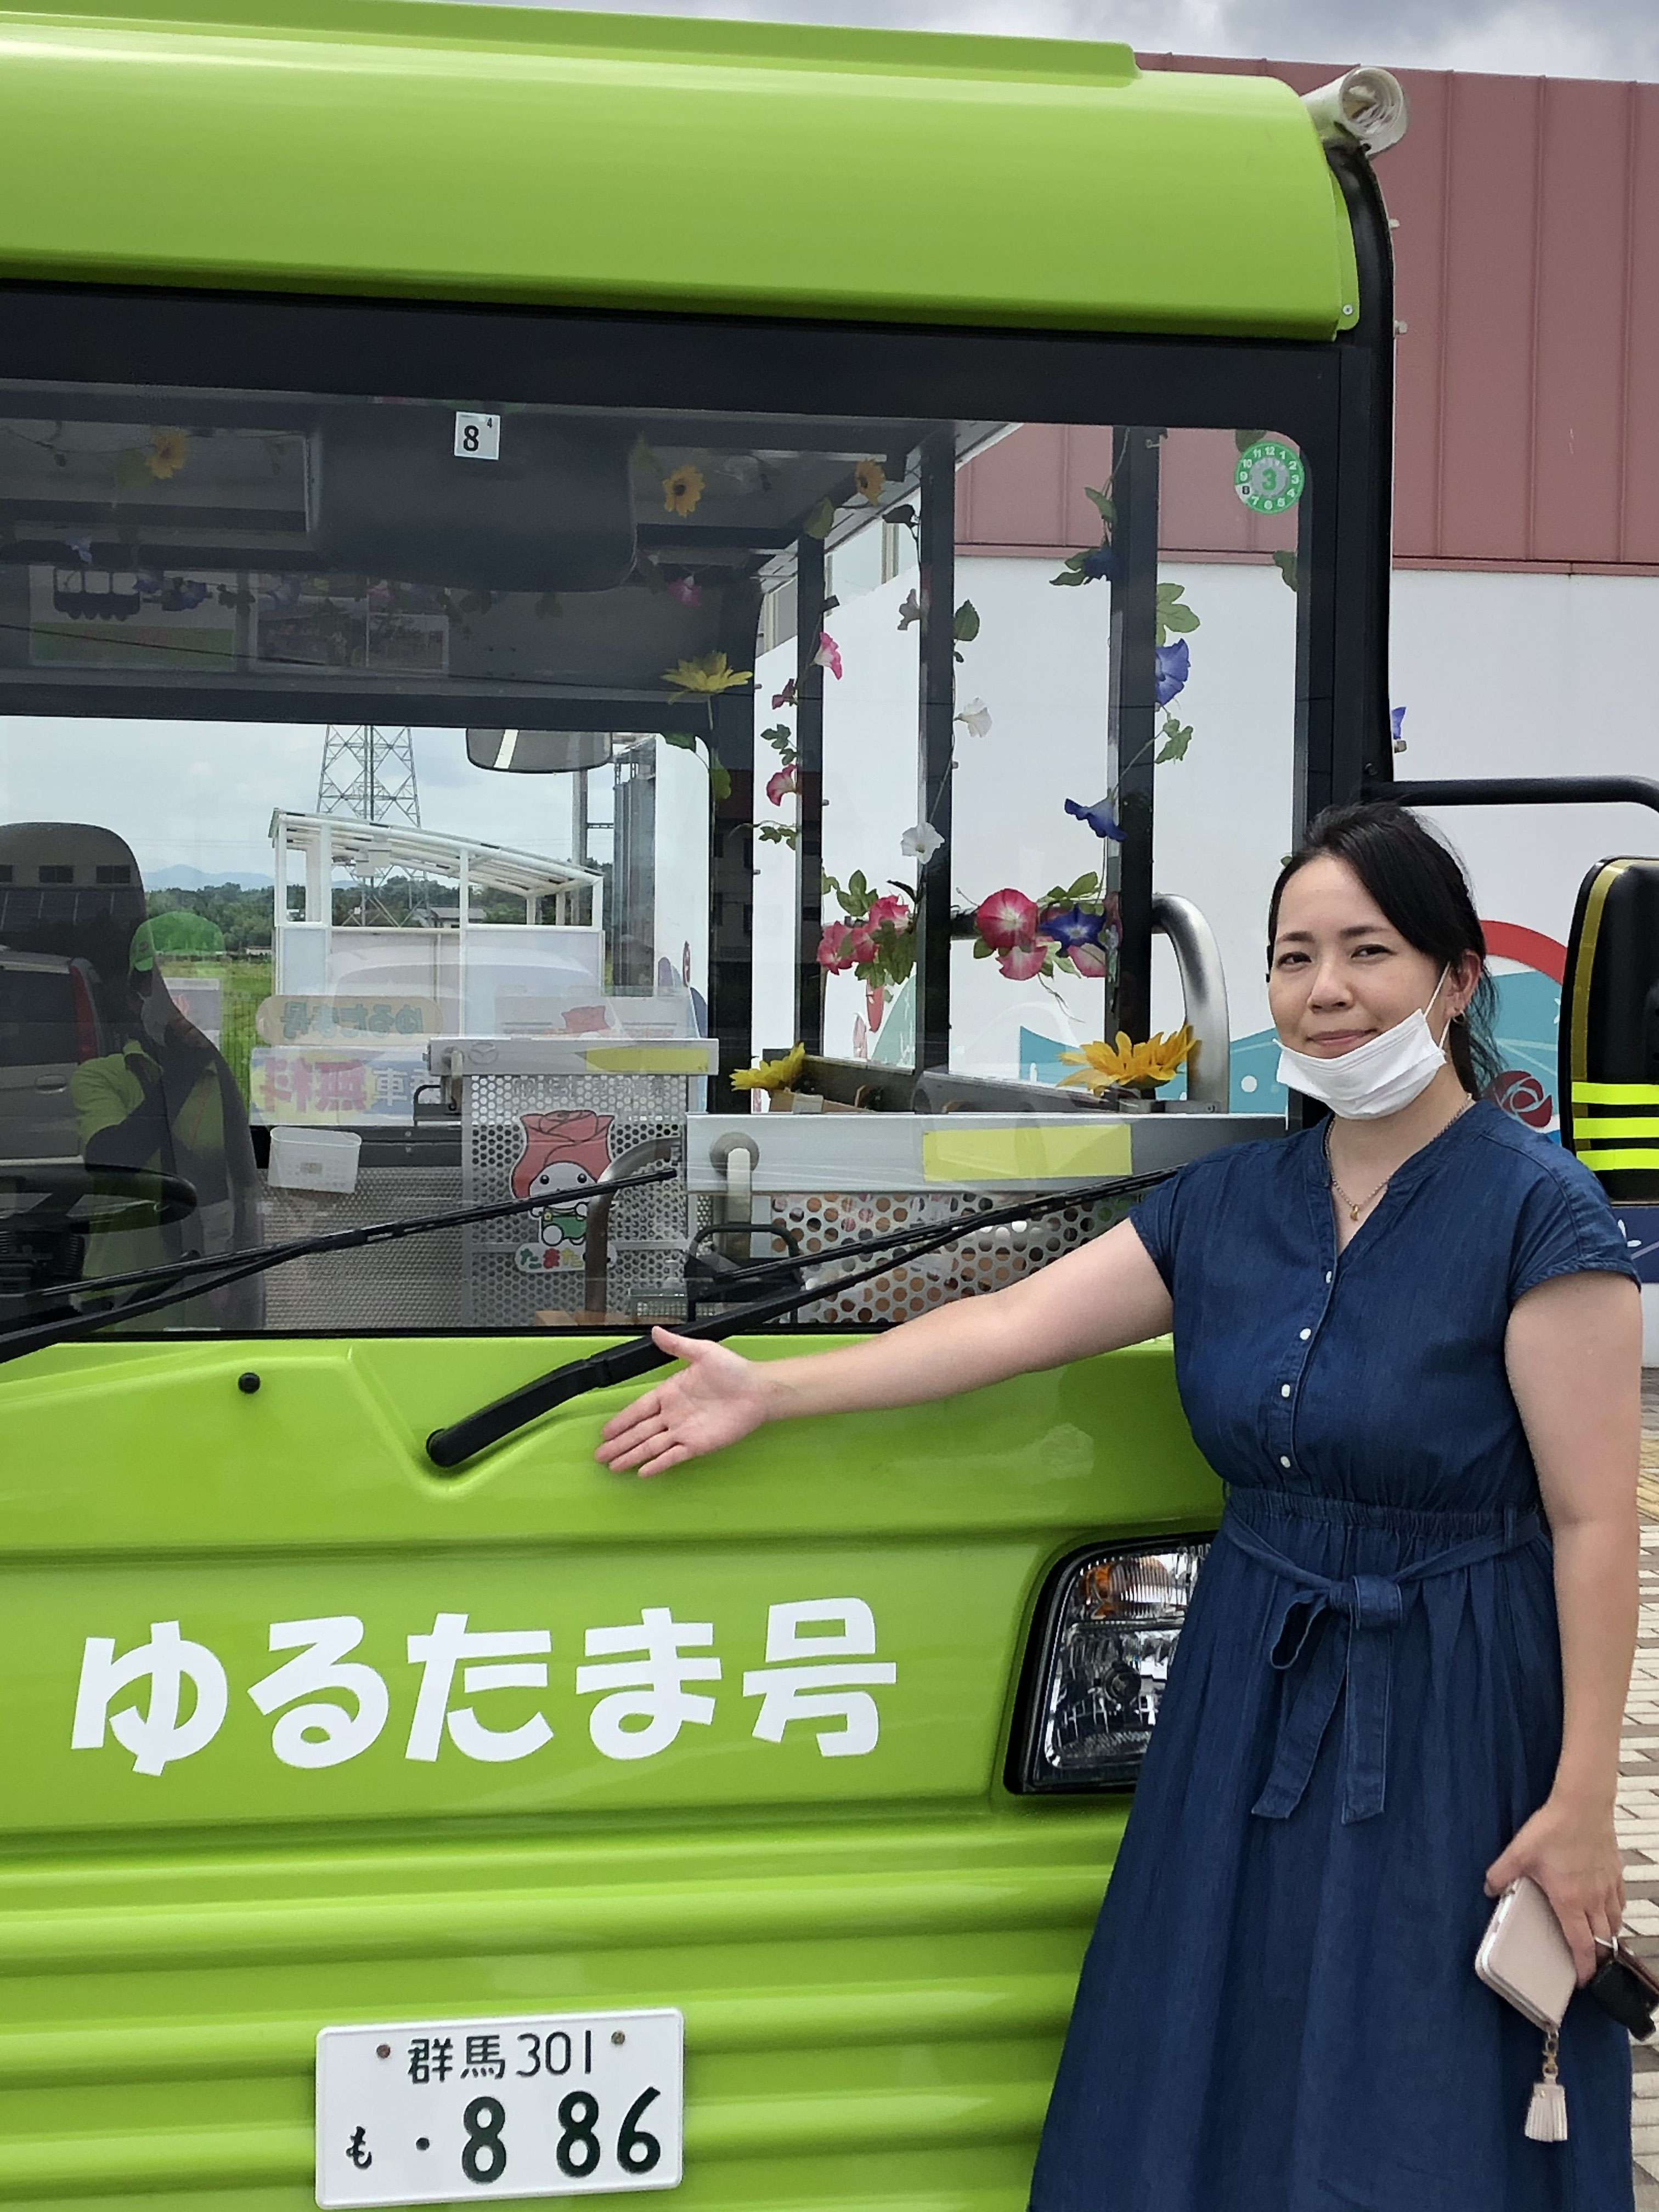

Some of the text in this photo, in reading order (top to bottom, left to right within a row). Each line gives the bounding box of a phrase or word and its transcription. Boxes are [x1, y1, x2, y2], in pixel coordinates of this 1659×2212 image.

[486, 417, 493, 428] 4
[463, 425, 479, 452] 8
[1253, 449, 1261, 458] 11
[1265, 446, 1275, 455] 12
[1279, 450, 1285, 460] 1
[1243, 459, 1252, 468] 10
[1289, 461, 1297, 470] 2
[1240, 471, 1248, 481] 9
[1262, 467, 1277, 490] 3
[1291, 474, 1299, 484] 3
[1286, 488, 1295, 498] 4
[1251, 496, 1260, 505] 7
[71, 1596, 897, 1776] ゆるたま号
